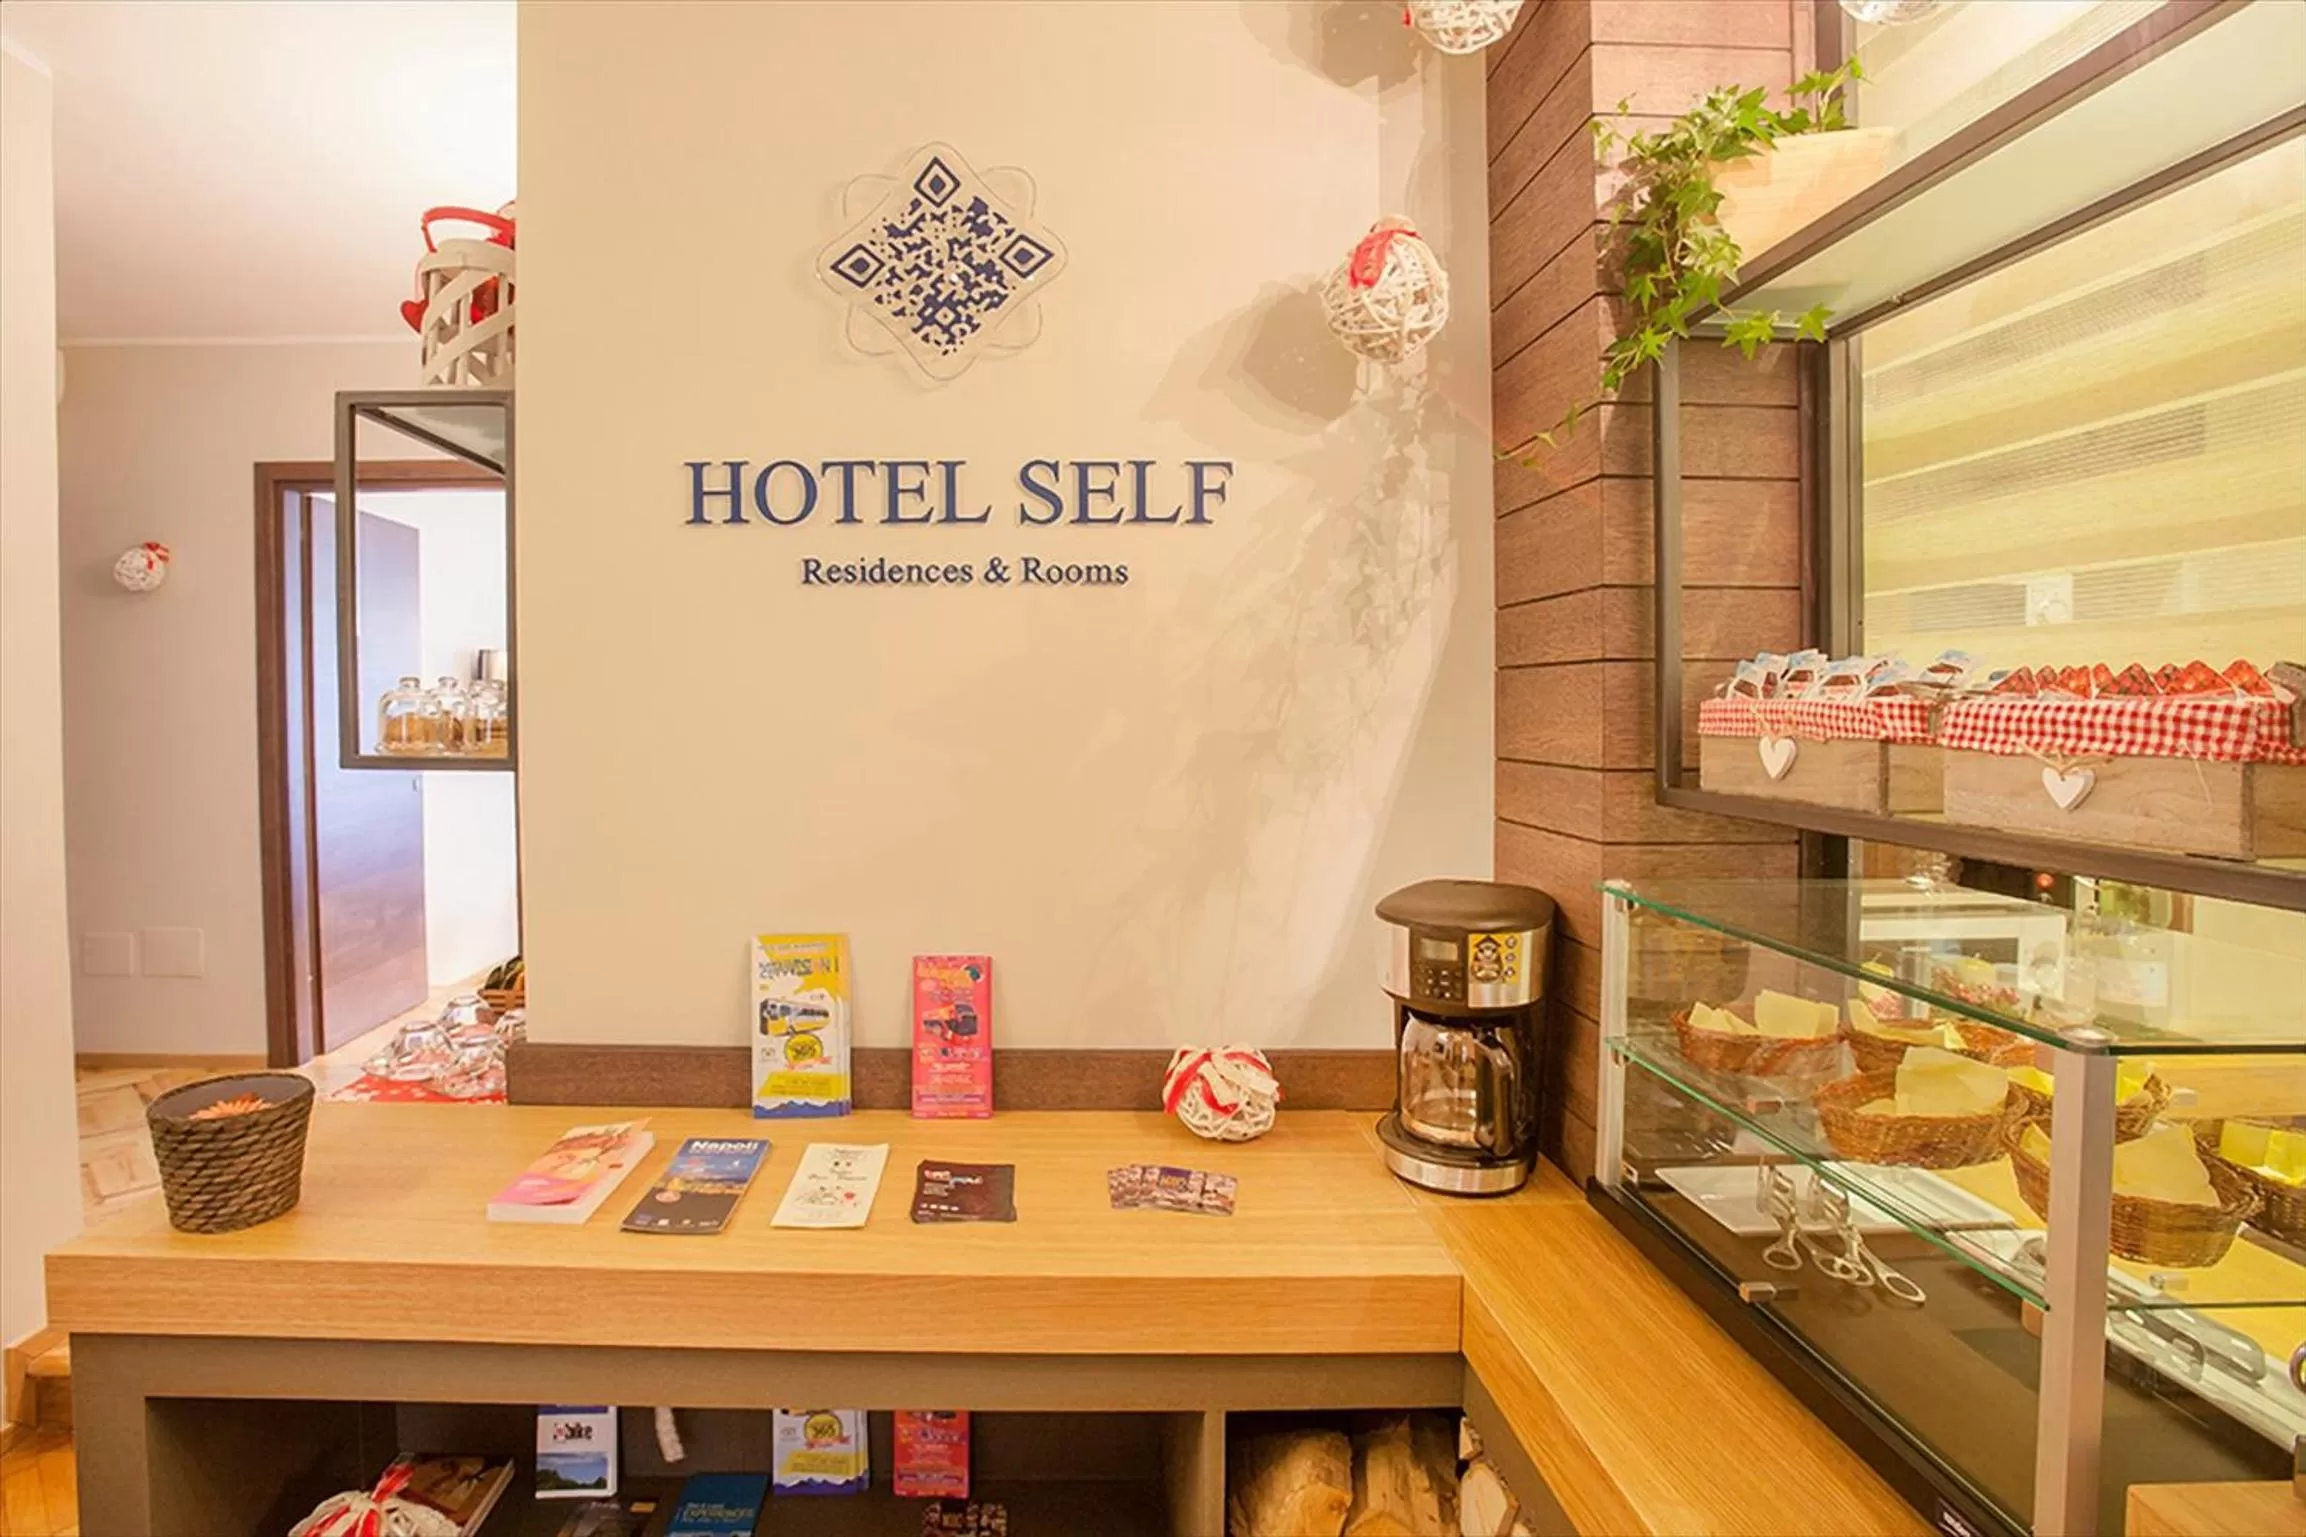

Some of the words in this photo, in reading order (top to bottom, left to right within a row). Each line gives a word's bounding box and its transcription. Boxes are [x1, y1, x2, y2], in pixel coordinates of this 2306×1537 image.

[684, 460, 992, 525] HOTEL
[1019, 459, 1233, 525] SELF
[802, 557, 973, 585] Residences
[984, 556, 1011, 585] &
[1022, 557, 1129, 585] Rooms
[690, 1140, 759, 1154] Napoli
